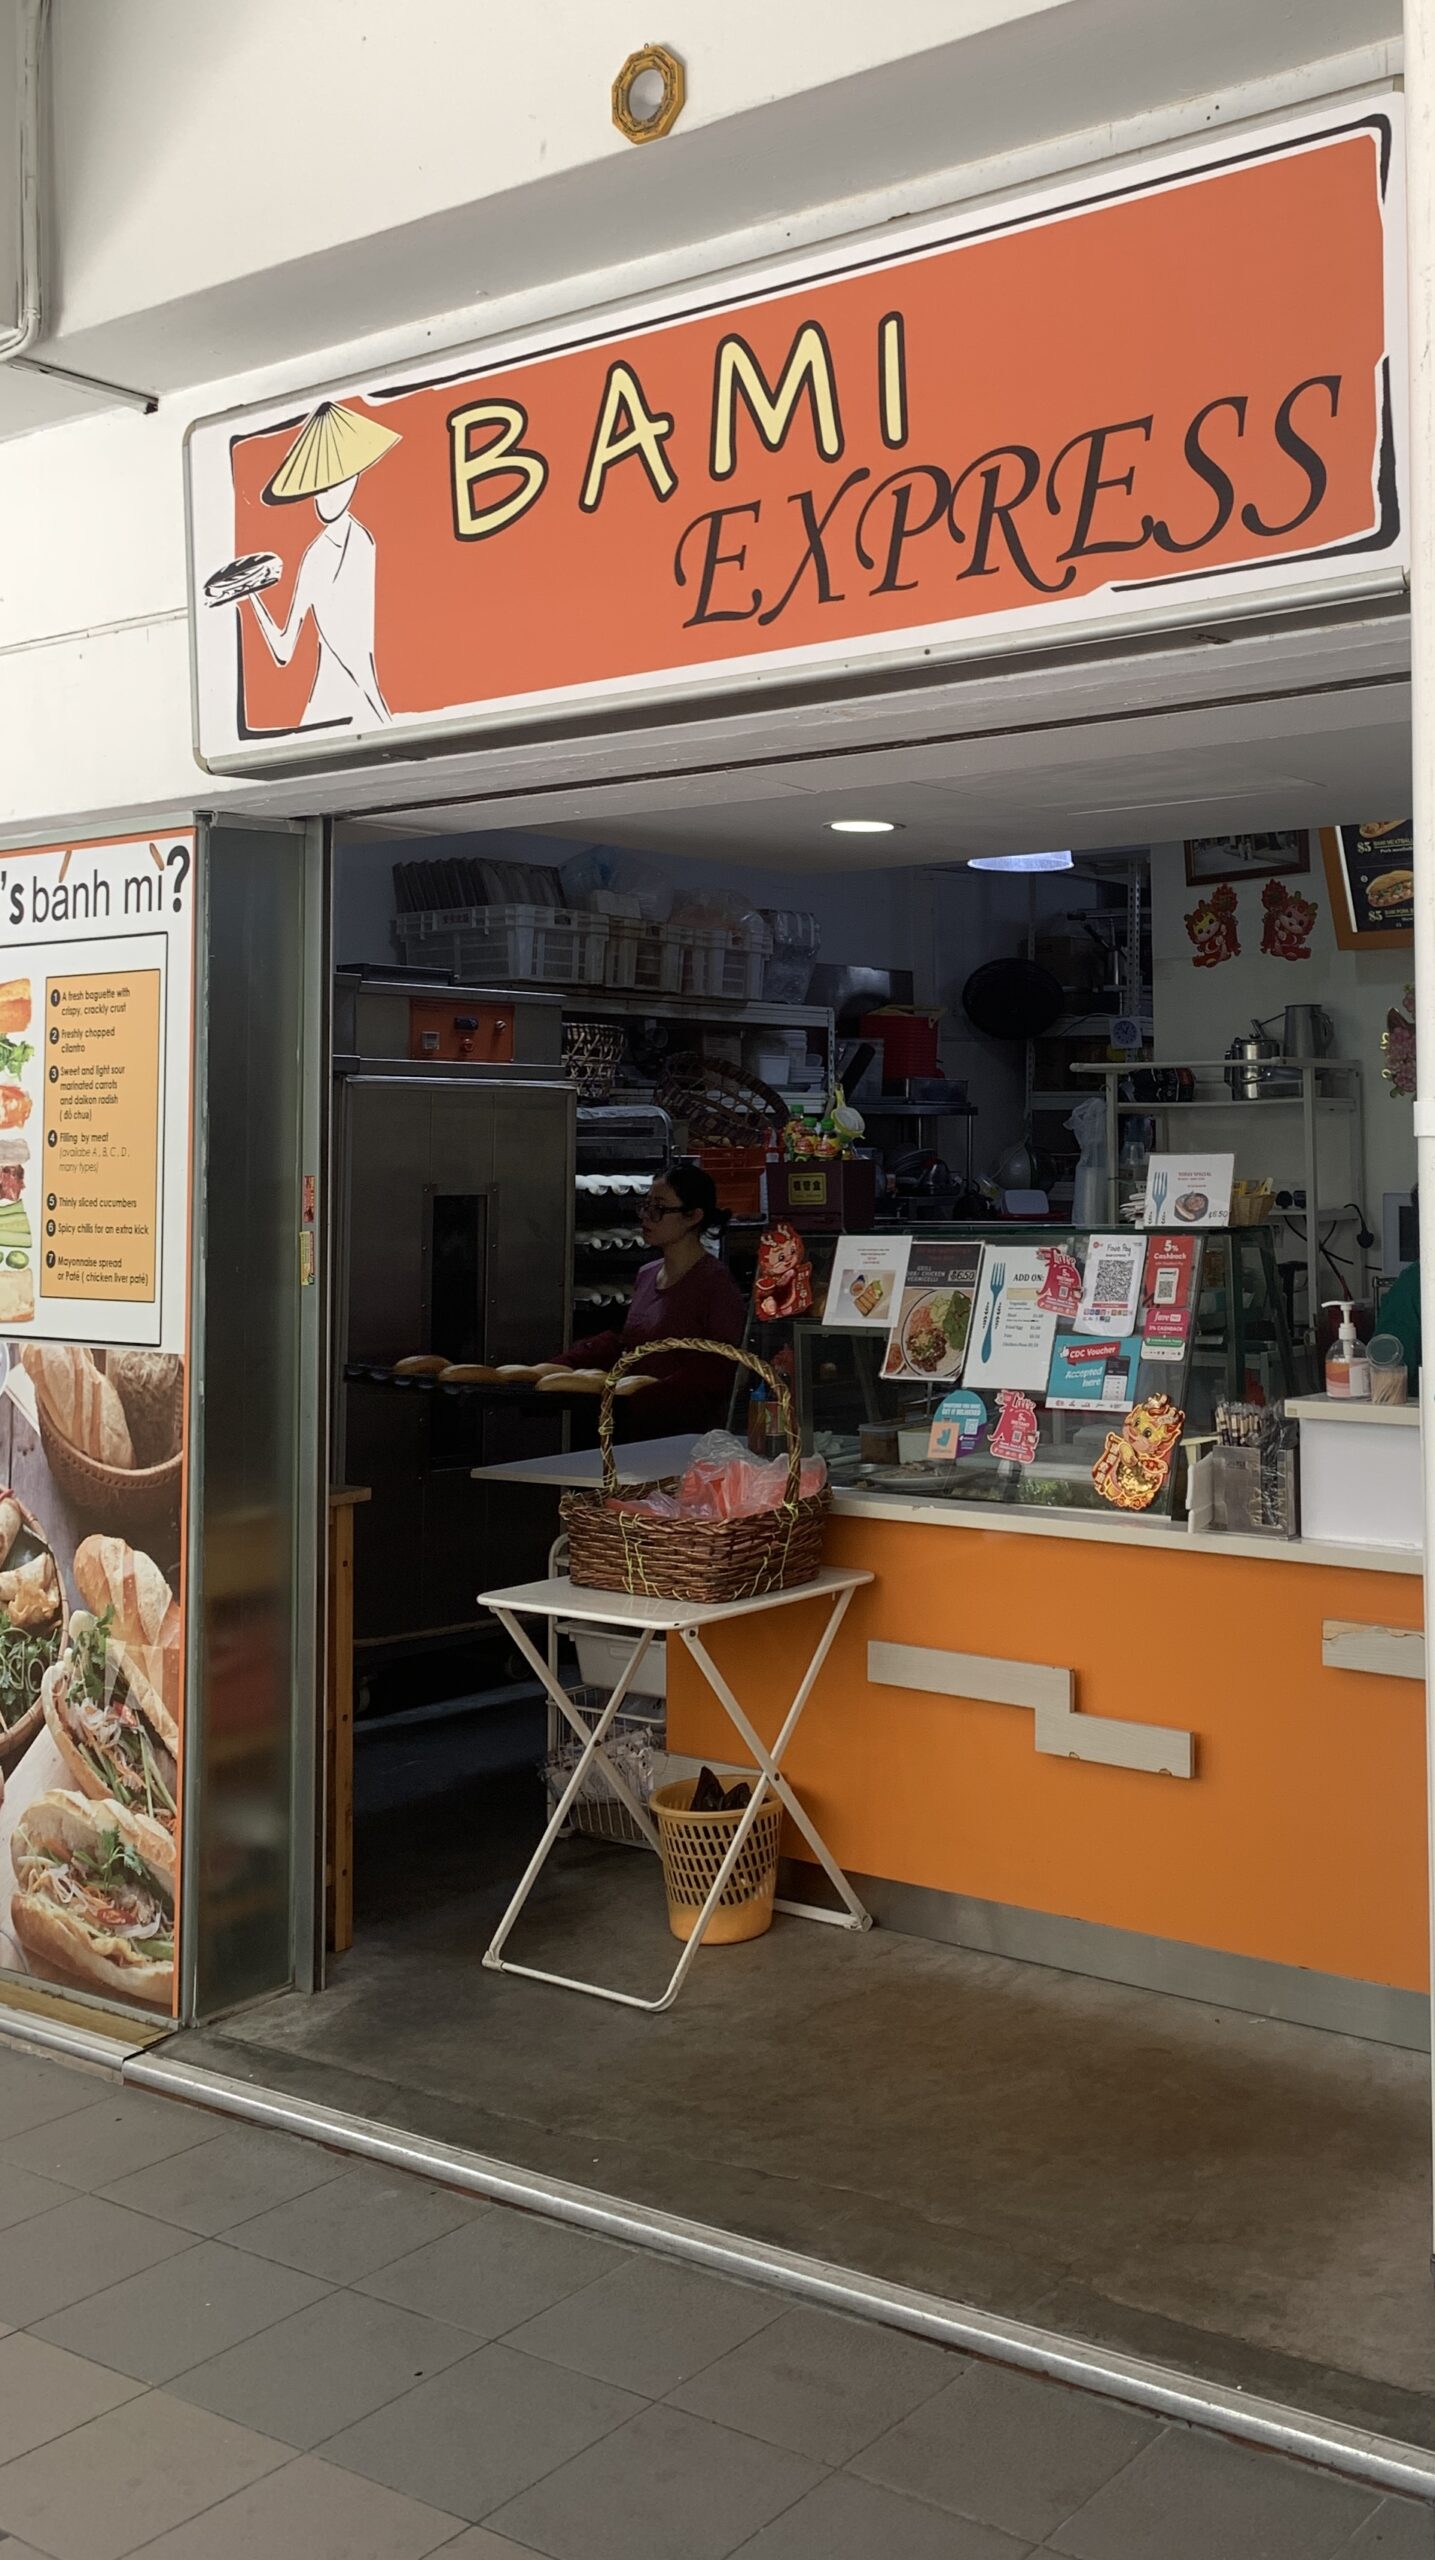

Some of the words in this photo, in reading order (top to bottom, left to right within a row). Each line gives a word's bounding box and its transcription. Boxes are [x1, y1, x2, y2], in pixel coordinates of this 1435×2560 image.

[447, 311, 909, 542] BAMI
[673, 375, 1342, 629] EXPRESS
[68, 990, 84, 1000] fresh
[85, 988, 115, 1002] baguette
[117, 987, 130, 998] with
[84, 1004, 108, 1015] crackly
[110, 1002, 126, 1013] crust
[62, 1029, 83, 1040] Freshly
[85, 1026, 115, 1039] chopped
[62, 1043, 85, 1054] cilantro
[60, 1066, 80, 1076] Sweet
[81, 1066, 94, 1075] and
[96, 1064, 110, 1077] light
[111, 1066, 125, 1074] sour
[60, 1080, 93, 1090] marinated
[95, 1080, 118, 1090] carrots
[60, 1096, 73, 1105] and
[74, 1095, 97, 1104] daikon
[98, 1094, 118, 1104] radish
[60, 1132, 78, 1144] Filling
[81, 1132, 89, 1144] by
[91, 1132, 108, 1142] meat
[59, 1163, 77, 1173] many
[59, 1197, 77, 1209] Thinly
[79, 1198, 98, 1208] sliced
[99, 1199, 136, 1208] cucumbers
[58, 1223, 75, 1235] Spicy
[95, 1224, 103, 1234] for
[105, 1226, 114, 1234] an
[116, 1225, 132, 1234] extra
[134, 1224, 149, 1235] kick
[1163, 1240, 1179, 1252] 5%
[58, 1256, 97, 1268] Mayonnaise
[99, 1258, 122, 1270] spread
[57, 1272, 64, 1280] or
[86, 1272, 113, 1282] chicken
[114, 1272, 128, 1283] liver
[1069, 1349, 1086, 1358] CDC
[1087, 1346, 1116, 1356] Voucher
[1065, 1366, 1103, 1379] Accepted
[1082, 1379, 1101, 1388] here
